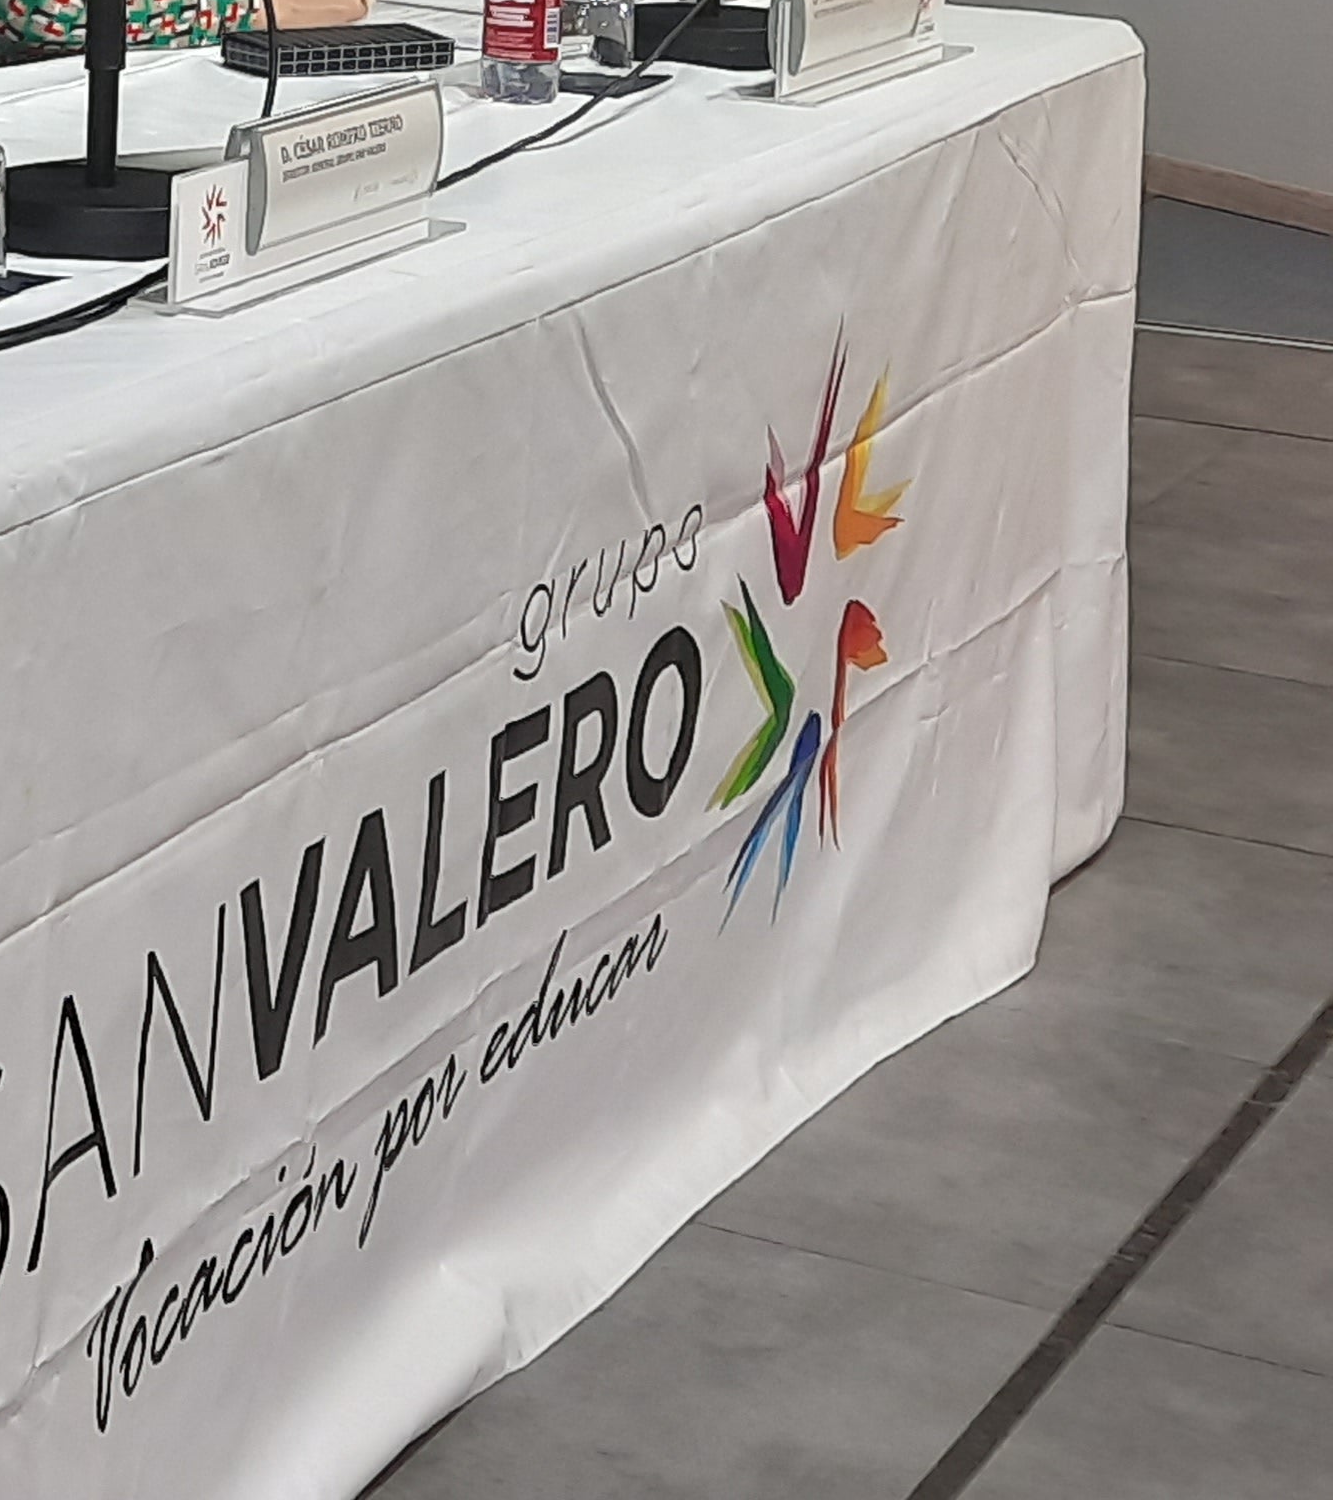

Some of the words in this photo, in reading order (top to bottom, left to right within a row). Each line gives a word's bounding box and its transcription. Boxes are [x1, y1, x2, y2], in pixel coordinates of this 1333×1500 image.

[513, 504, 703, 681] grupo
[87, 1142, 358, 1434] Vocación
[358, 1053, 468, 1250] por
[480, 913, 669, 1084] educar
